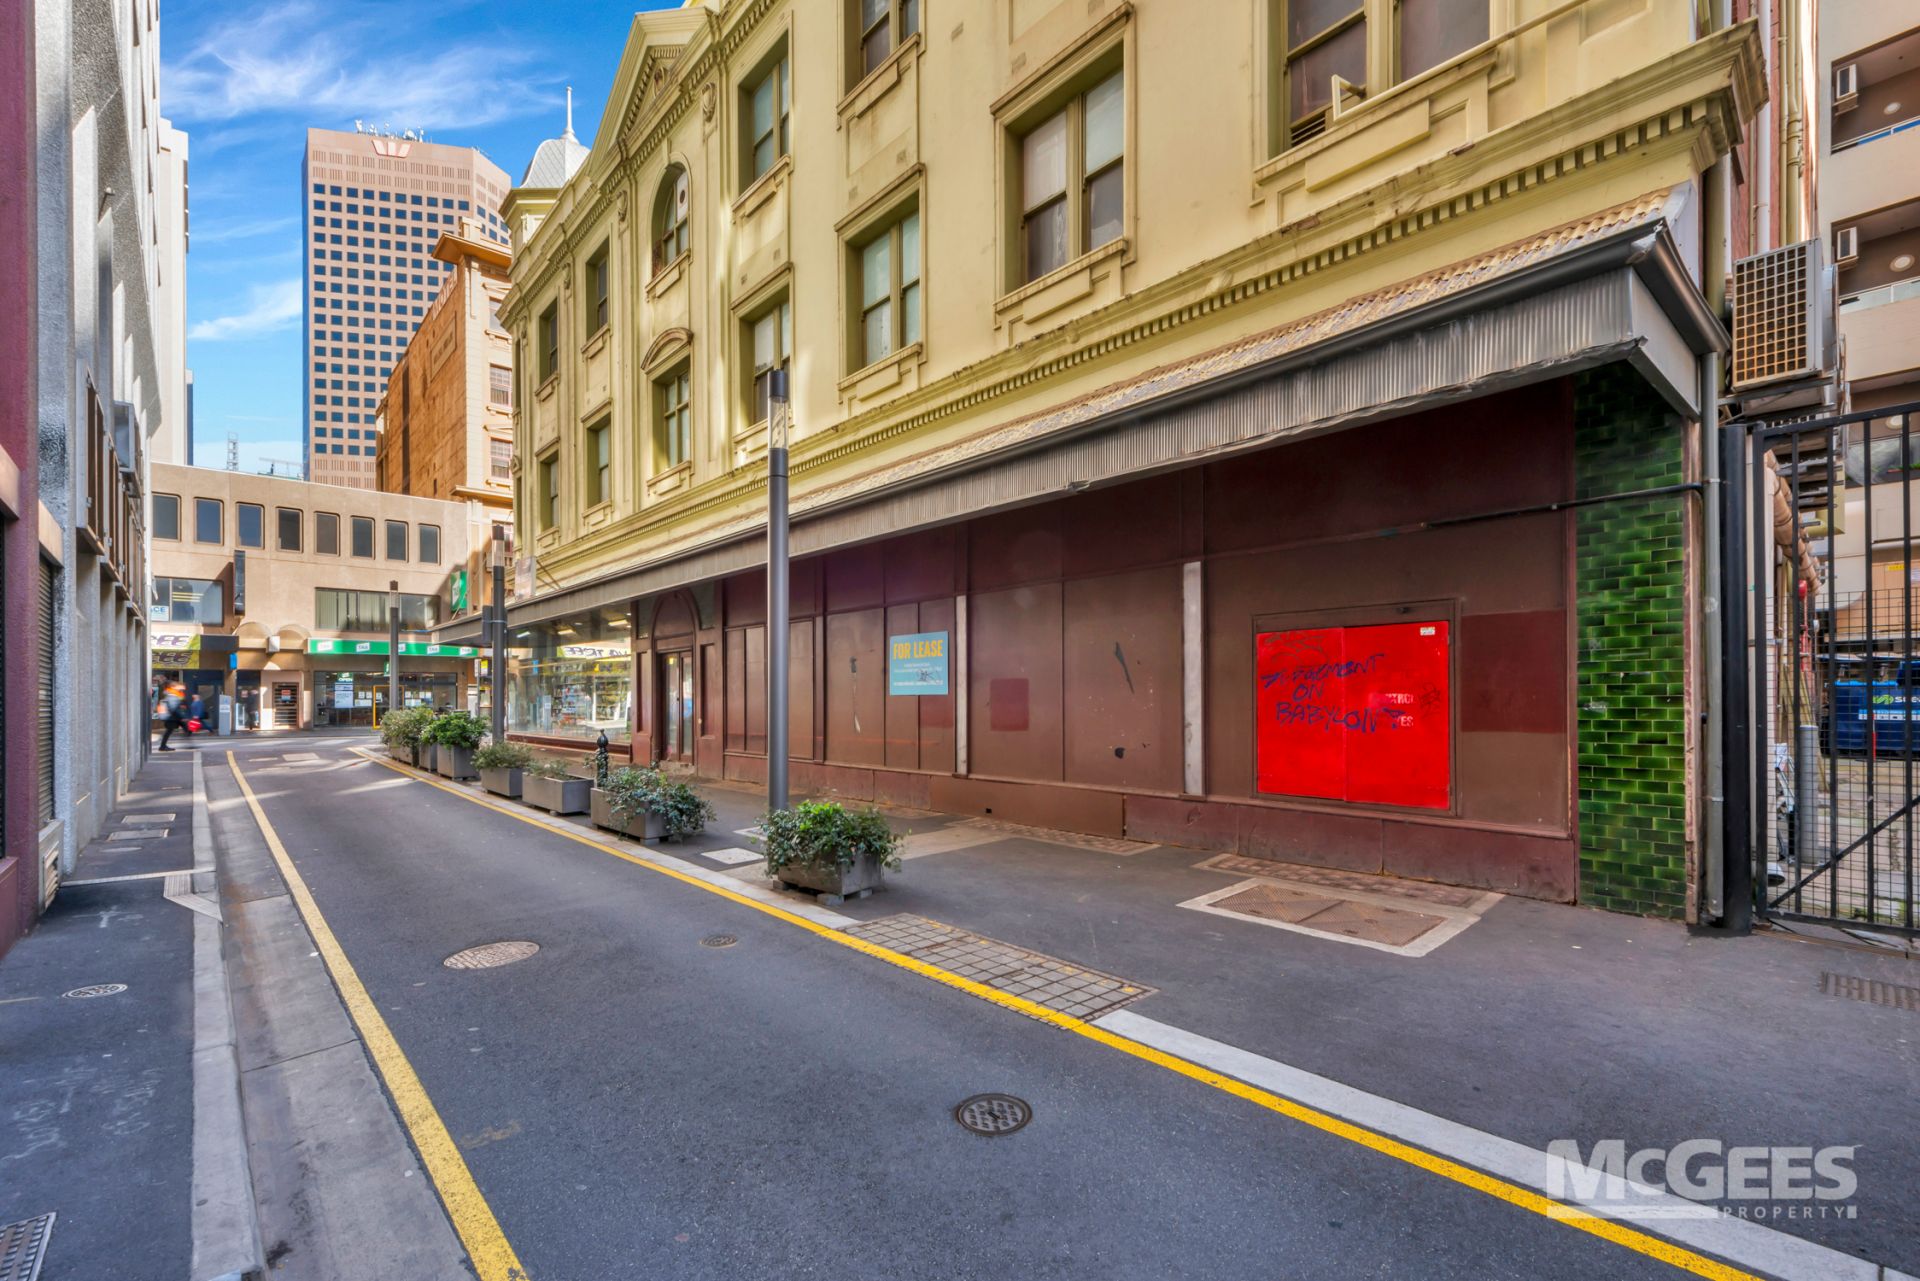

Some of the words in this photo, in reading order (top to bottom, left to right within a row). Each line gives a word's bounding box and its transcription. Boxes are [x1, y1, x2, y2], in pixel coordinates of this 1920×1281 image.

[893, 642, 911, 660] FOR
[914, 639, 944, 658] LEASE
[1292, 682, 1324, 702] ON
